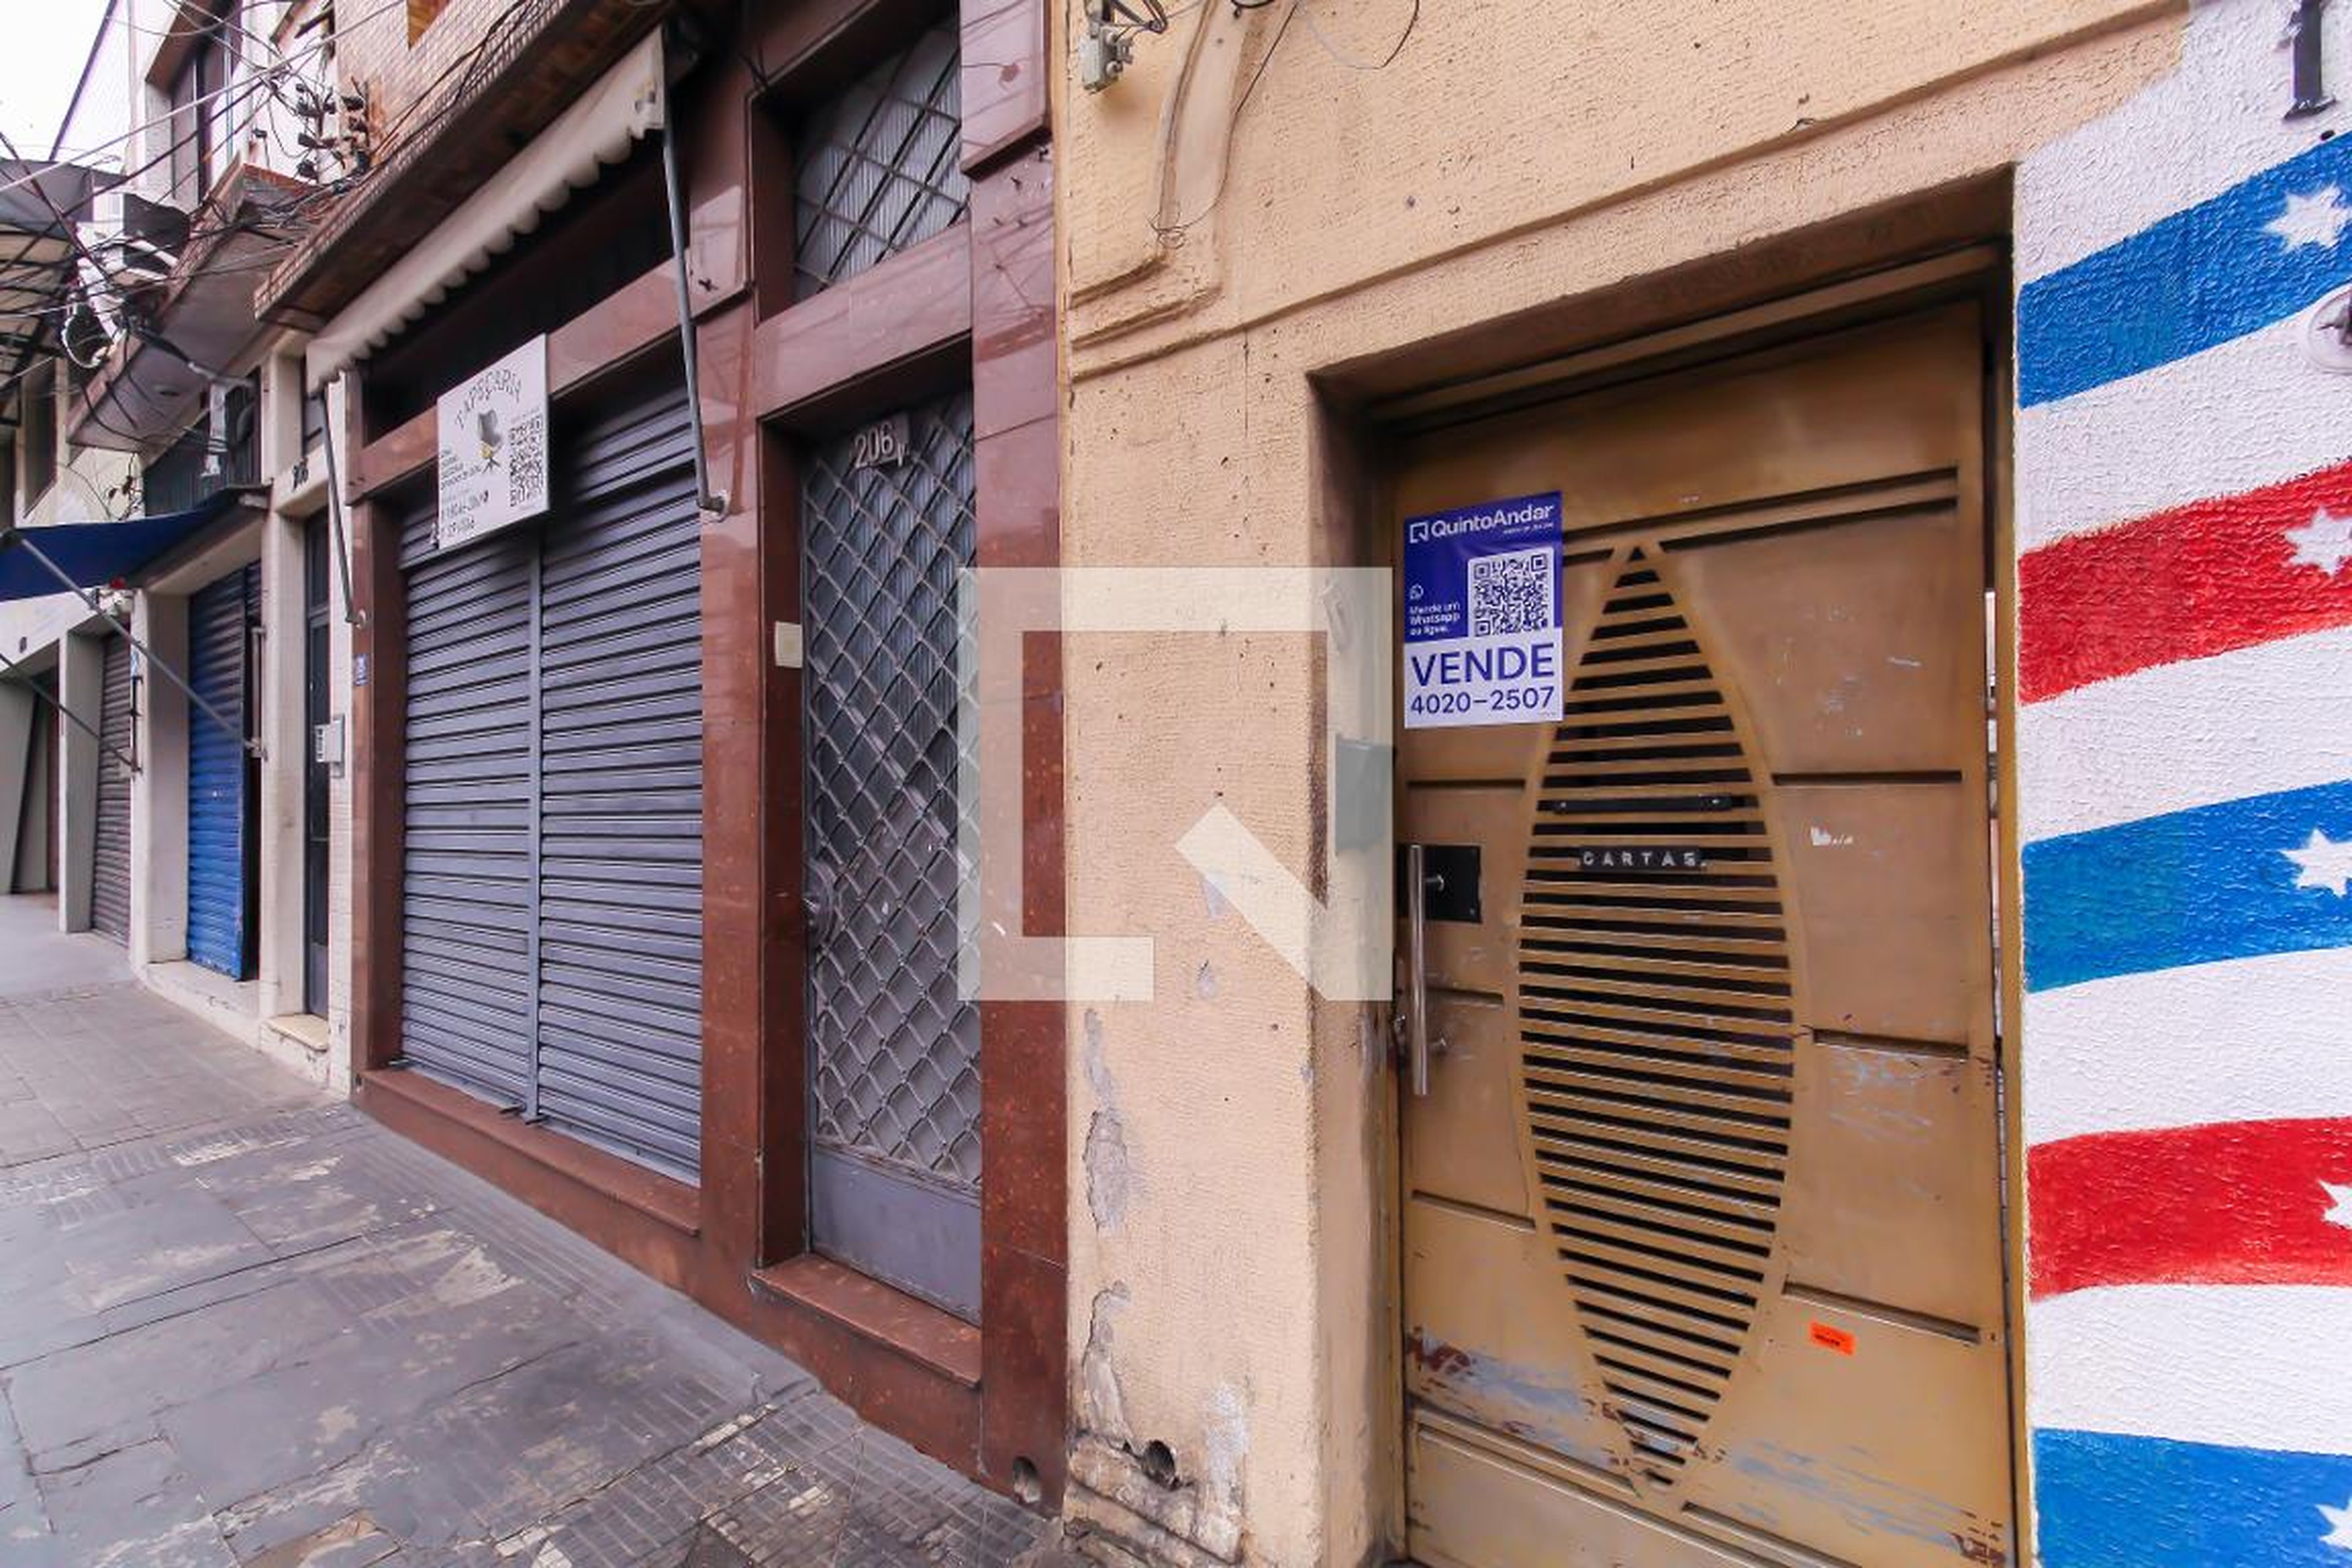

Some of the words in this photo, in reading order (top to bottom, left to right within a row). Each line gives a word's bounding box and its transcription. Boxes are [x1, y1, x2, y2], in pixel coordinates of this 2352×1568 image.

[854, 422, 894, 469] 206
[1431, 504, 1555, 537] QuintoAndar
[1411, 643, 1555, 687] VENDE
[1411, 686, 1555, 715] 4020-2507
[1583, 850, 1697, 867] CARTAS
